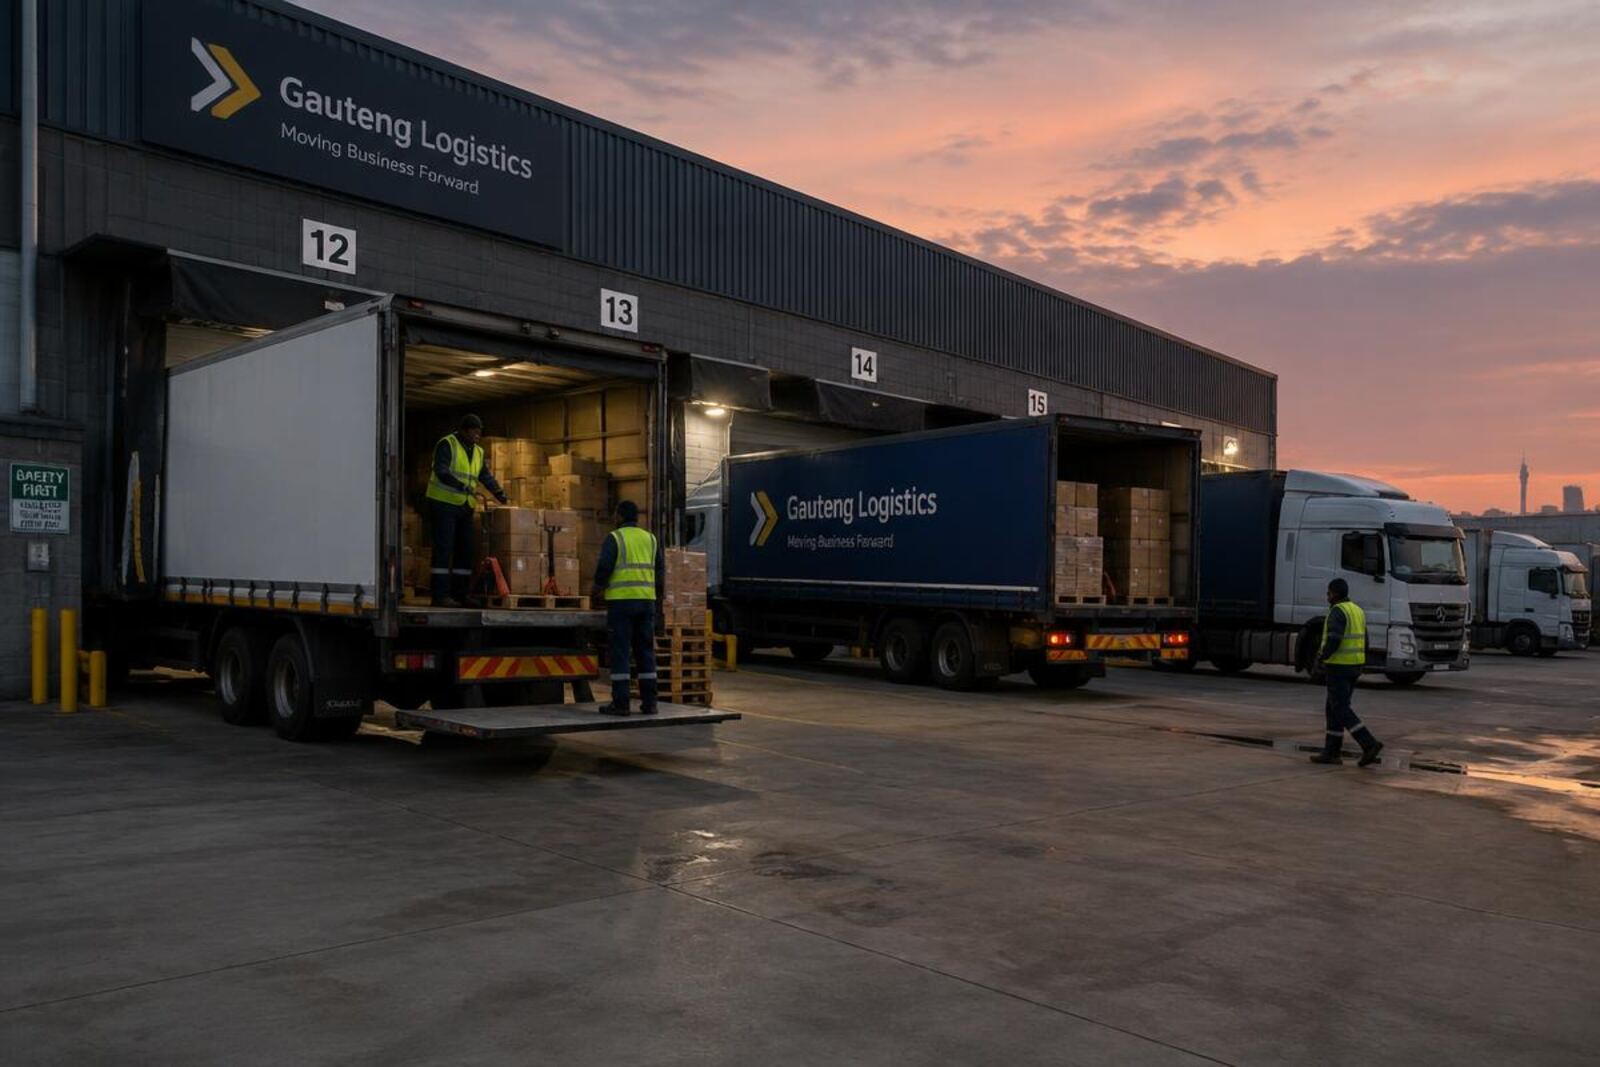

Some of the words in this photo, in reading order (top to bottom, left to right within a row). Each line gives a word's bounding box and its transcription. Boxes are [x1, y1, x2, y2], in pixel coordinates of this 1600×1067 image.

[280, 76, 412, 149] Gauteng
[421, 120, 533, 179] Logistics
[281, 122, 342, 158] Moving
[347, 143, 415, 177] Business
[419, 164, 480, 196] Forward
[311, 229, 349, 266] 12
[606, 296, 632, 325] 13
[855, 353, 874, 377] 14
[1030, 394, 1045, 414] 15
[787, 495, 853, 525] Gauteng
[858, 486, 938, 524] Logistics
